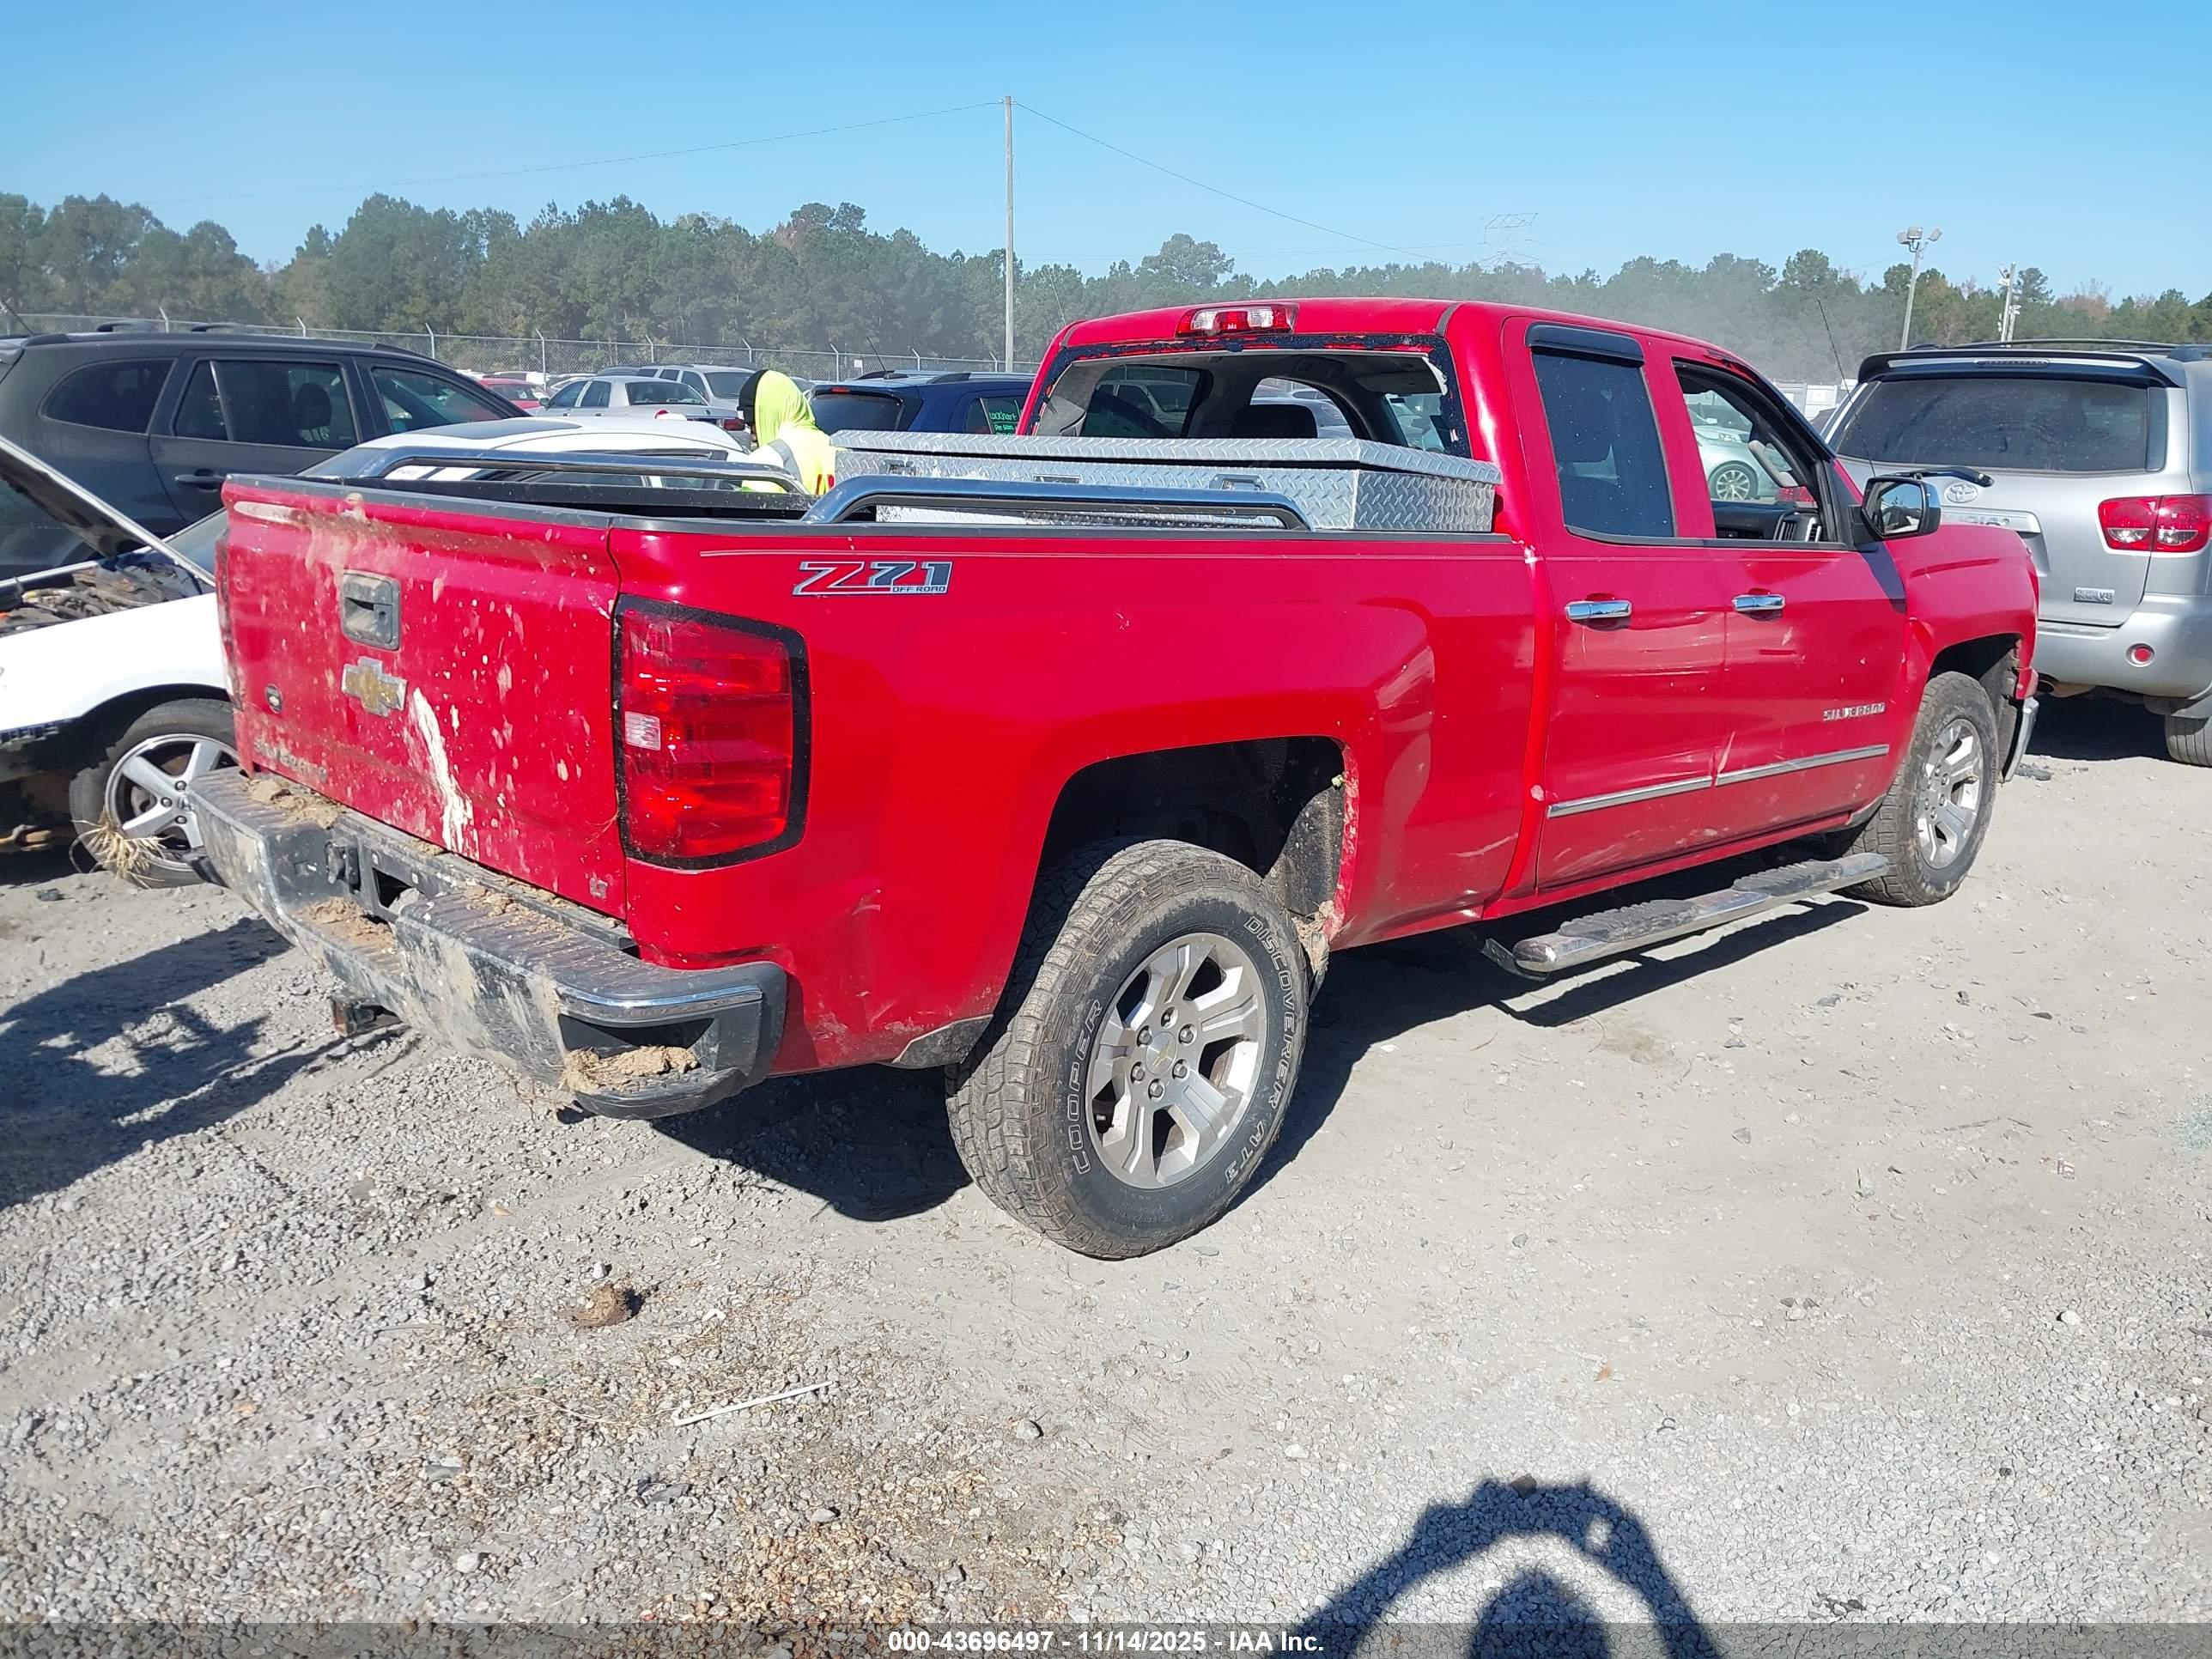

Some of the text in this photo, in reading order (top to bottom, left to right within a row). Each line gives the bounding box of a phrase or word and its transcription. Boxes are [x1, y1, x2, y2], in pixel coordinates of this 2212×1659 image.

[793, 561, 953, 595] Z71
[1067, 1000, 1103, 1175] COOPER
[1243, 916, 1295, 1110] DISCOVERER
